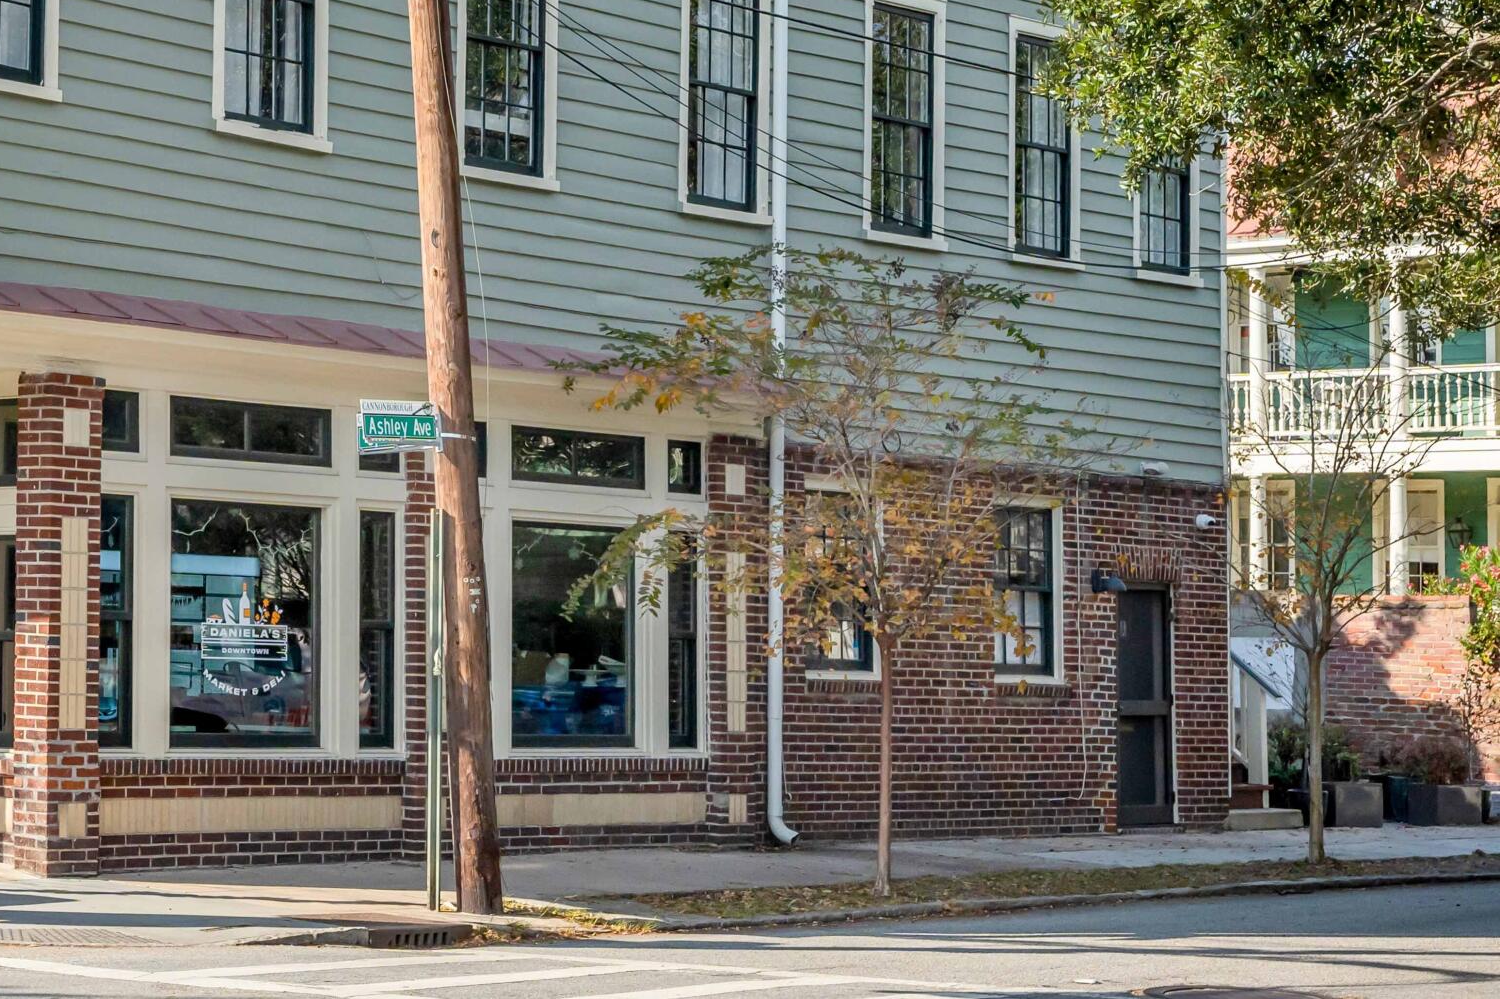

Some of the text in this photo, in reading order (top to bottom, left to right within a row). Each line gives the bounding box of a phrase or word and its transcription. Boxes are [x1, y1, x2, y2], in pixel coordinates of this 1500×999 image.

[369, 416, 408, 438] Ashley
[413, 418, 432, 436] Ave
[210, 627, 280, 639] DANIELA'S
[221, 647, 270, 655] DOWNTOWN
[202, 668, 286, 696] MARKET & DELI
